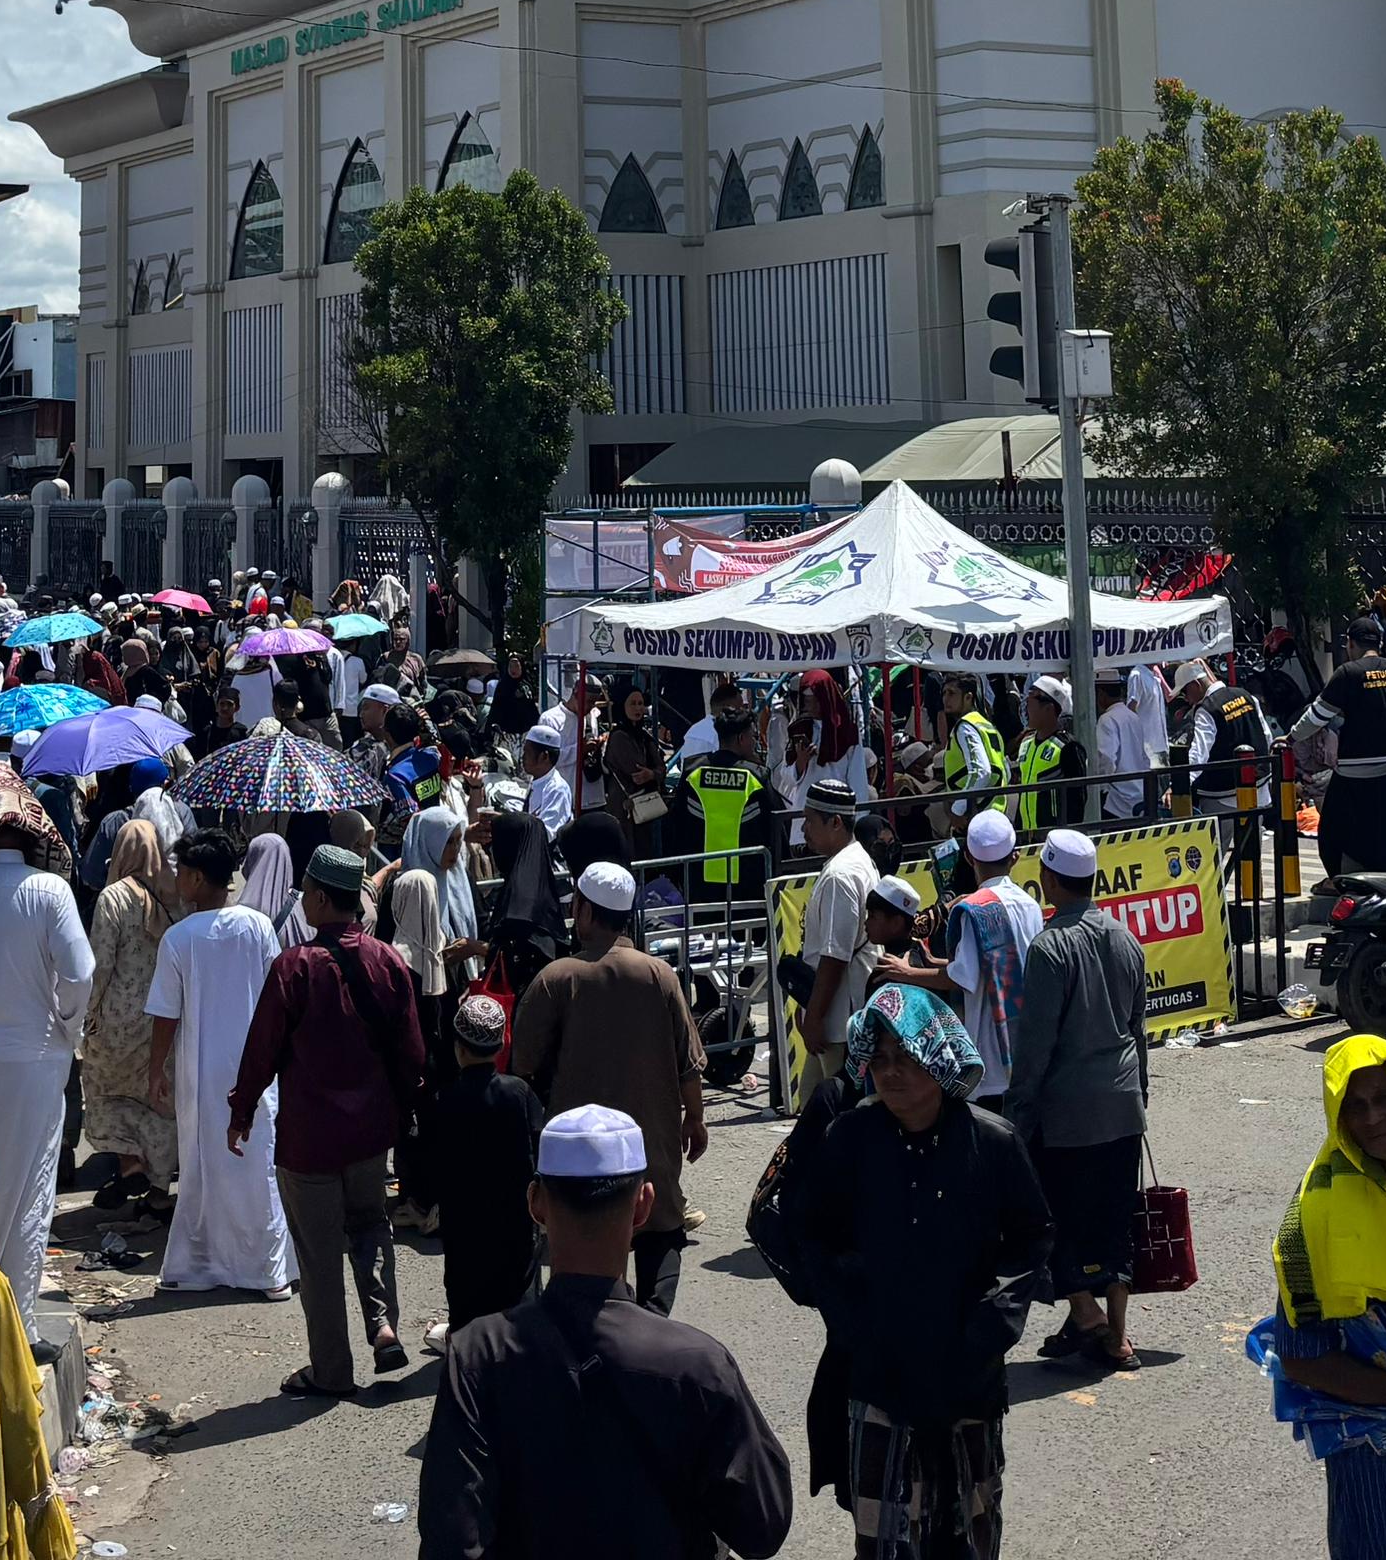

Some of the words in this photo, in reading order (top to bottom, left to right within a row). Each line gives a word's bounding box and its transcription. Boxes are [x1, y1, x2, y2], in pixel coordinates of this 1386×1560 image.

[231, 35, 289, 76] MASJID
[623, 627, 681, 657] POSKO
[683, 628, 775, 661] SEKUMPUL
[775, 632, 837, 661] DEPAN
[946, 632, 1015, 661] POSKO
[1021, 628, 1125, 660] SEKUPUL
[1129, 624, 1186, 653] DEPAN
[704, 770, 745, 787] SEDAP
[1146, 991, 1193, 1011] ERTUGAS
